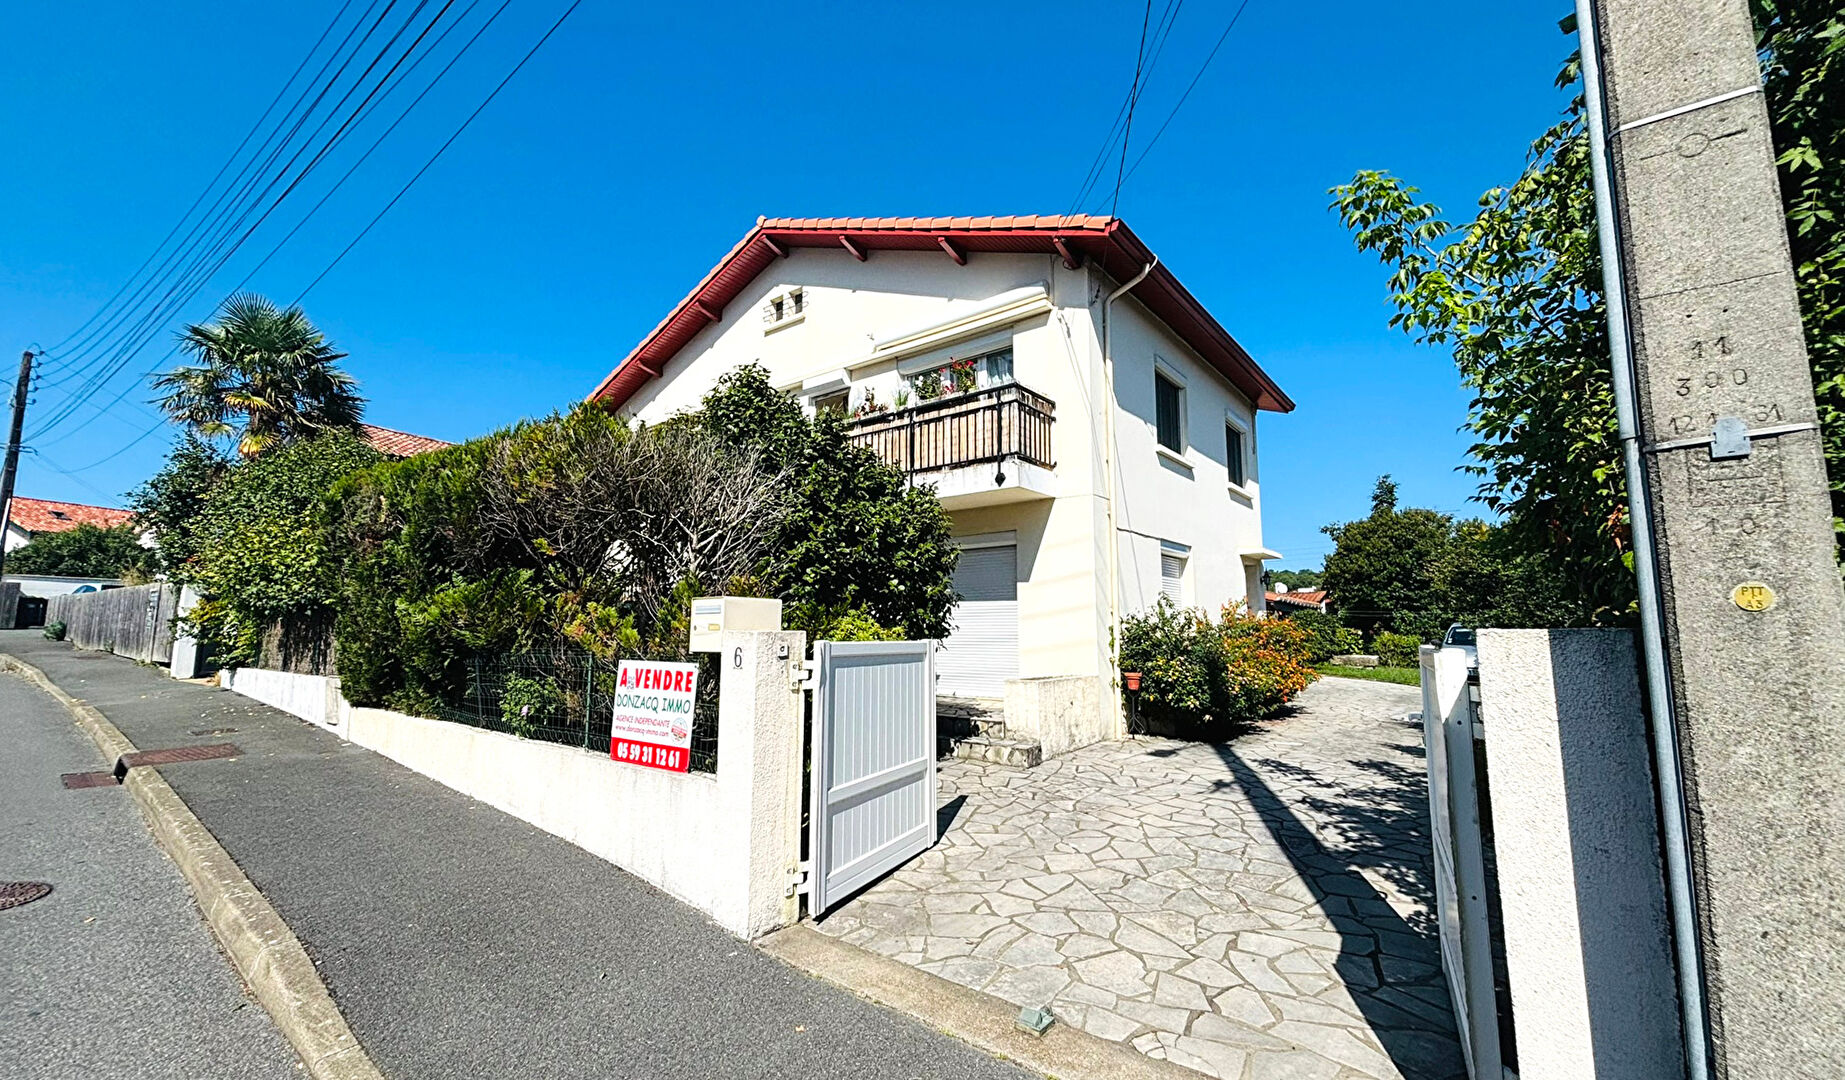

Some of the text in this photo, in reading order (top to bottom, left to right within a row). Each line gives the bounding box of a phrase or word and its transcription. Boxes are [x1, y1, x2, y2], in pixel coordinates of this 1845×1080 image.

[1741, 586, 1764, 596] PTT
[734, 646, 743, 668] 6
[619, 667, 694, 692] A VENDRE
[616, 693, 691, 714] DONZACQ IMMO
[617, 741, 681, 768] 05 59 31 12 61
